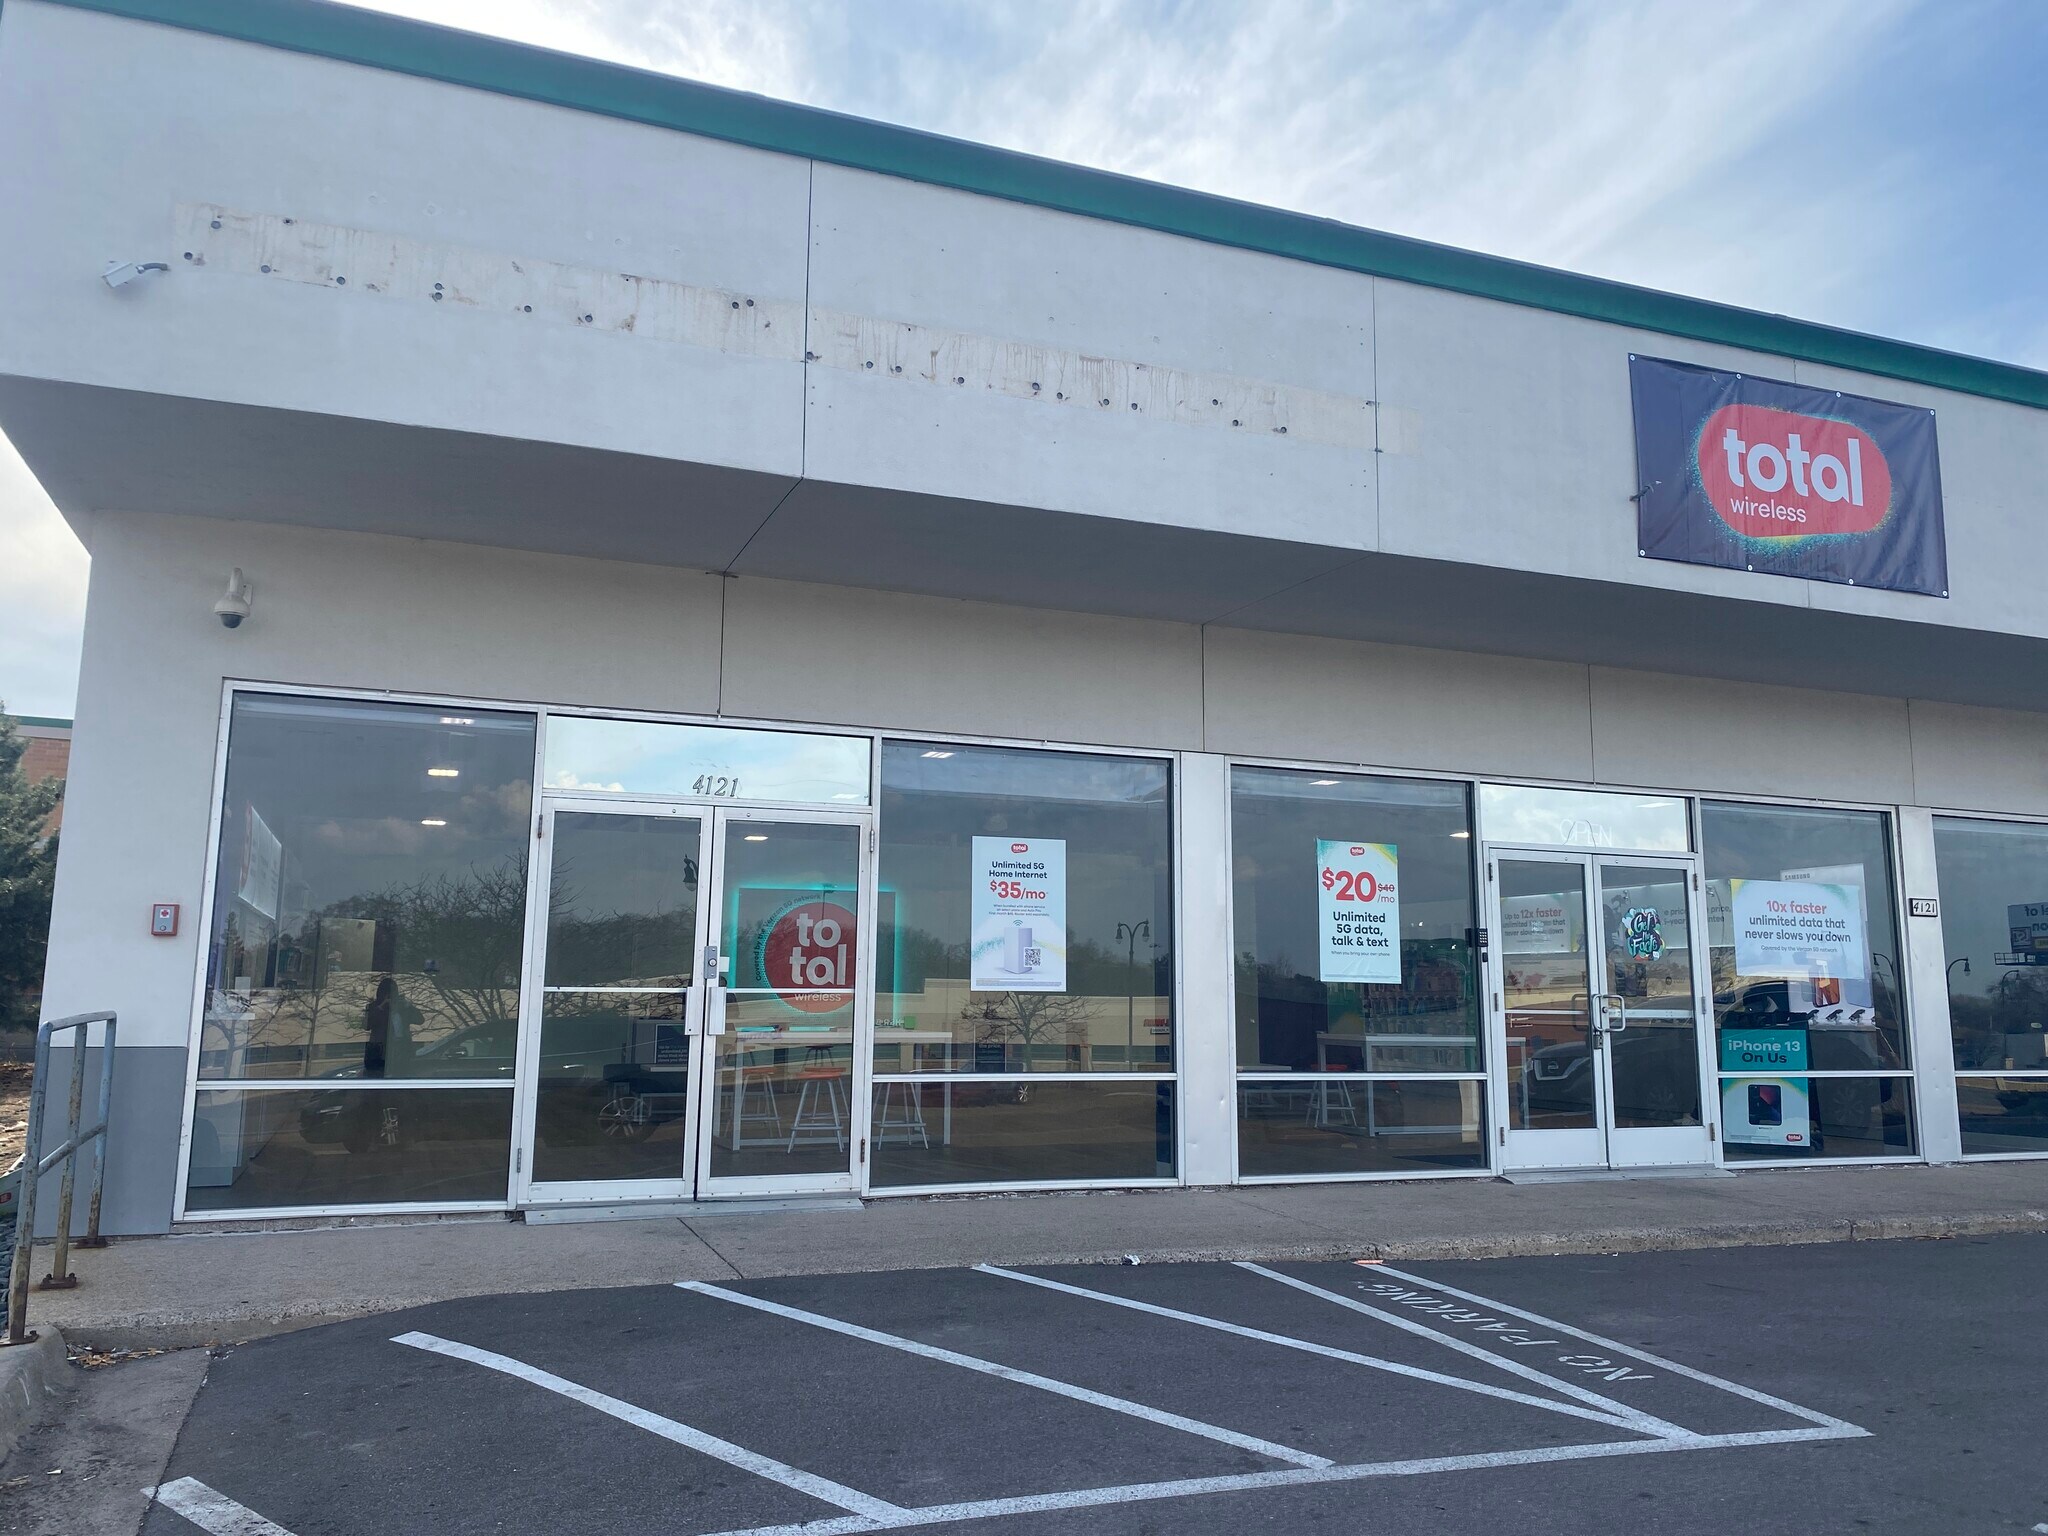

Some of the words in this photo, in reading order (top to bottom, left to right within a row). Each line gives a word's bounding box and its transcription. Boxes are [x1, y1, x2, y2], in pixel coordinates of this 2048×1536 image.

[1723, 428, 1863, 507] total
[1730, 496, 1807, 523] wireless
[692, 774, 739, 797] 4121
[1559, 818, 1612, 847] OPEN
[991, 861, 1032, 870] Unlimited
[1033, 862, 1045, 870] 5G
[988, 870, 1013, 878] Home
[1014, 870, 1048, 879] Internet
[1321, 867, 1377, 903] $20
[1377, 894, 1396, 904] /mo
[1520, 909, 1534, 919] 12x
[1535, 907, 1562, 918] faster
[1766, 900, 1787, 913] 10x
[1790, 901, 1827, 914] faster
[1913, 902, 1935, 913] 4121
[1333, 911, 1386, 923] Unlimited
[1633, 913, 1653, 933] Get
[1749, 915, 1796, 927] unlimited
[1798, 916, 1823, 928] data
[1824, 917, 1846, 929] that
[796, 912, 842, 948] to
[1336, 923, 1351, 934] 5G
[1354, 924, 1384, 936] data,
[1331, 935, 1353, 946] talk
[1356, 937, 1364, 947] &
[1366, 937, 1389, 948] text
[1744, 929, 1774, 940] never
[1776, 929, 1803, 941] slows
[1805, 932, 1823, 945] you
[1825, 931, 1851, 943] down
[789, 943, 847, 986] tal
[794, 991, 842, 1002] wireless
[1728, 1039, 1782, 1051] iPhone
[1784, 1040, 1801, 1052] 13
[1741, 1052, 1763, 1063] On
[1767, 1052, 1787, 1064] Us
[1357, 1282, 1560, 1347] PARKING
[1557, 1354, 1655, 1382] NO
